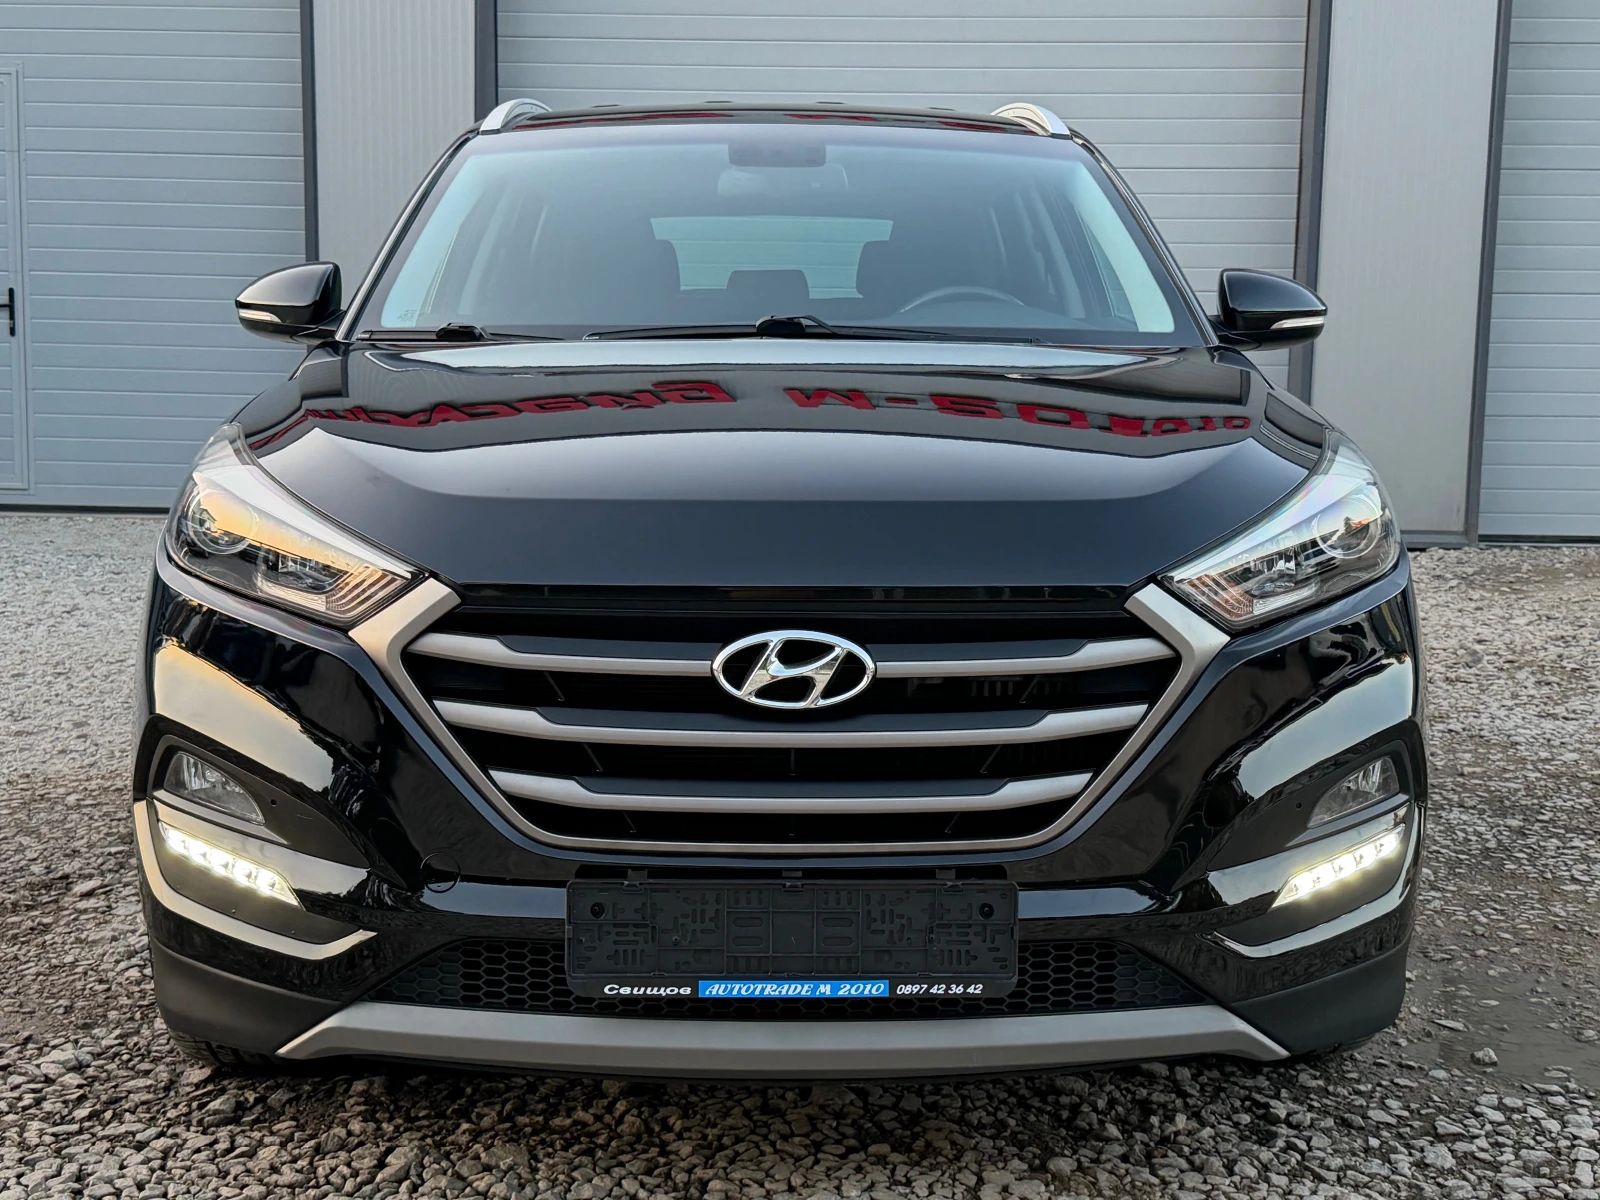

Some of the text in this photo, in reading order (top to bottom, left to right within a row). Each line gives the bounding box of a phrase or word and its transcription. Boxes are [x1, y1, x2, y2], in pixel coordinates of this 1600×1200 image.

[603, 983, 692, 997] Свищов
[704, 982, 885, 997] AUTOTRADE M 2010
[896, 983, 984, 996] 0897 42 36 42
